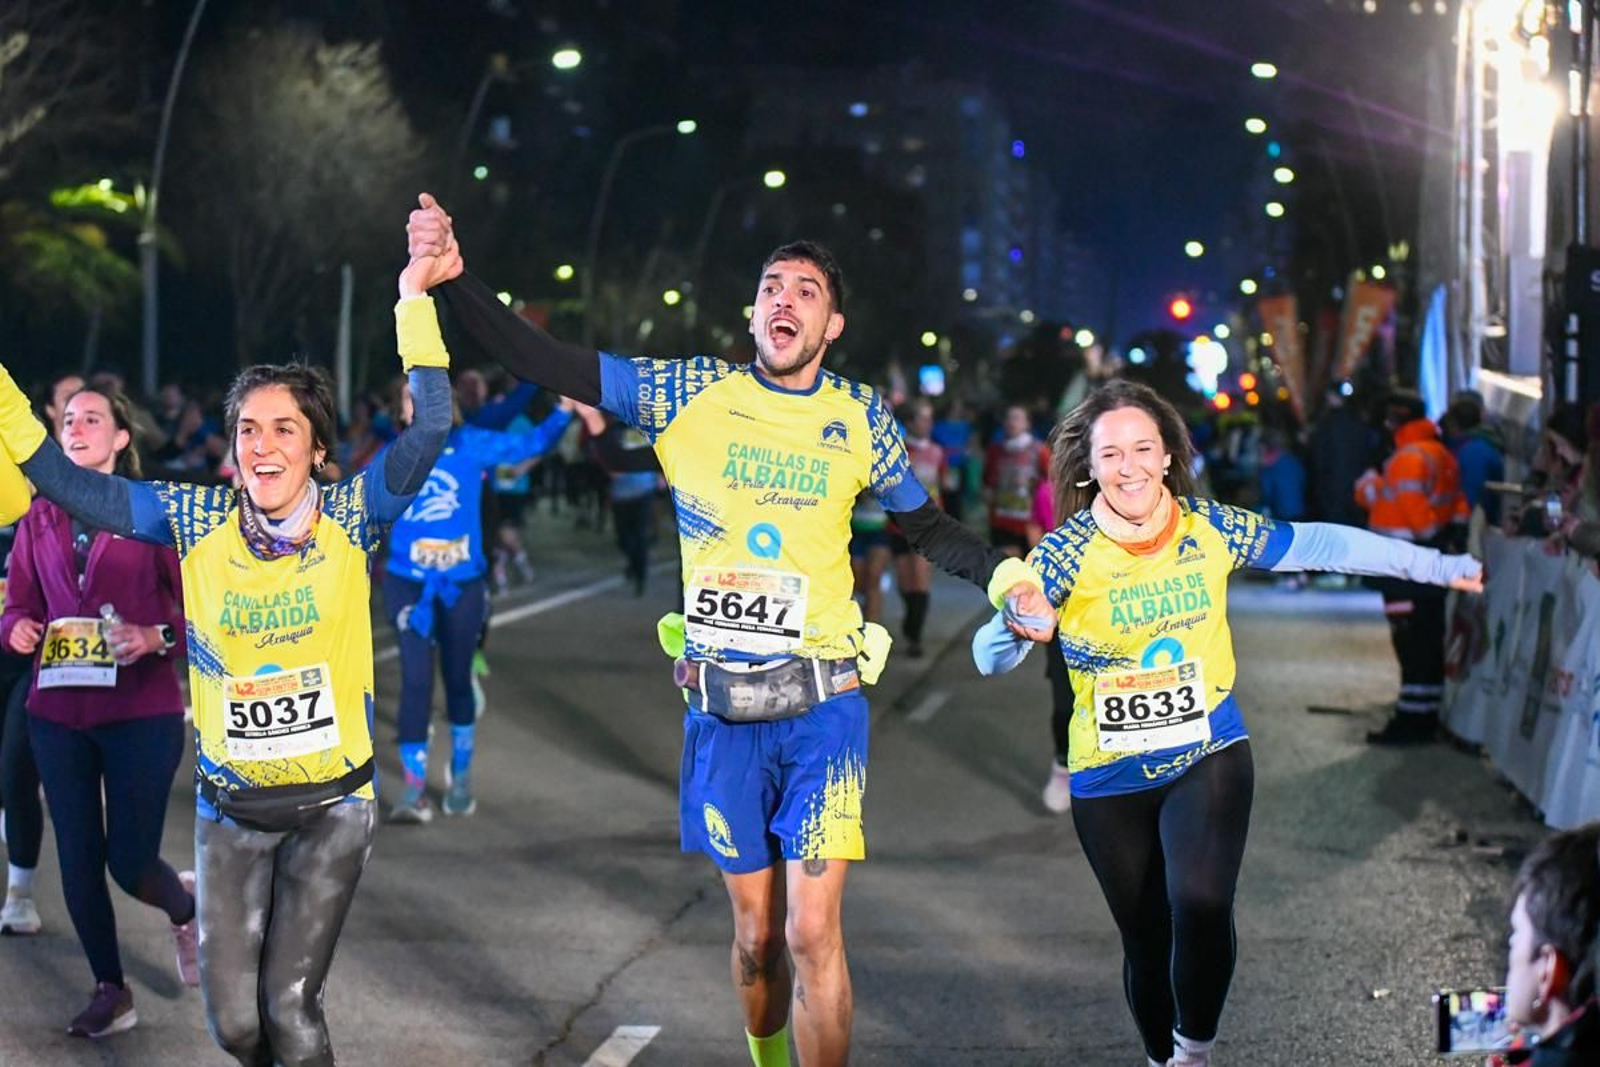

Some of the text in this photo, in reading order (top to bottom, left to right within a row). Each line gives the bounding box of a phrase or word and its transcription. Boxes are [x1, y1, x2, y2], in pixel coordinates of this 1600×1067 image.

[651, 387, 672, 429] colina
[728, 443, 806, 471] CANILLAS
[810, 458, 830, 477] DE
[723, 459, 828, 498] ALBAIDA
[718, 572, 737, 587] 42
[1109, 572, 1205, 605] CANILLAS DE
[224, 585, 314, 610] CANILLAS DE
[696, 588, 796, 626] 5647
[1111, 588, 1212, 627] ALBAIDA
[219, 603, 320, 630] ALBAIDA
[46, 637, 109, 661] 3634
[235, 682, 256, 696] 42
[1115, 675, 1136, 689] 42
[229, 690, 320, 729] 5037
[1104, 685, 1195, 723] 8633
